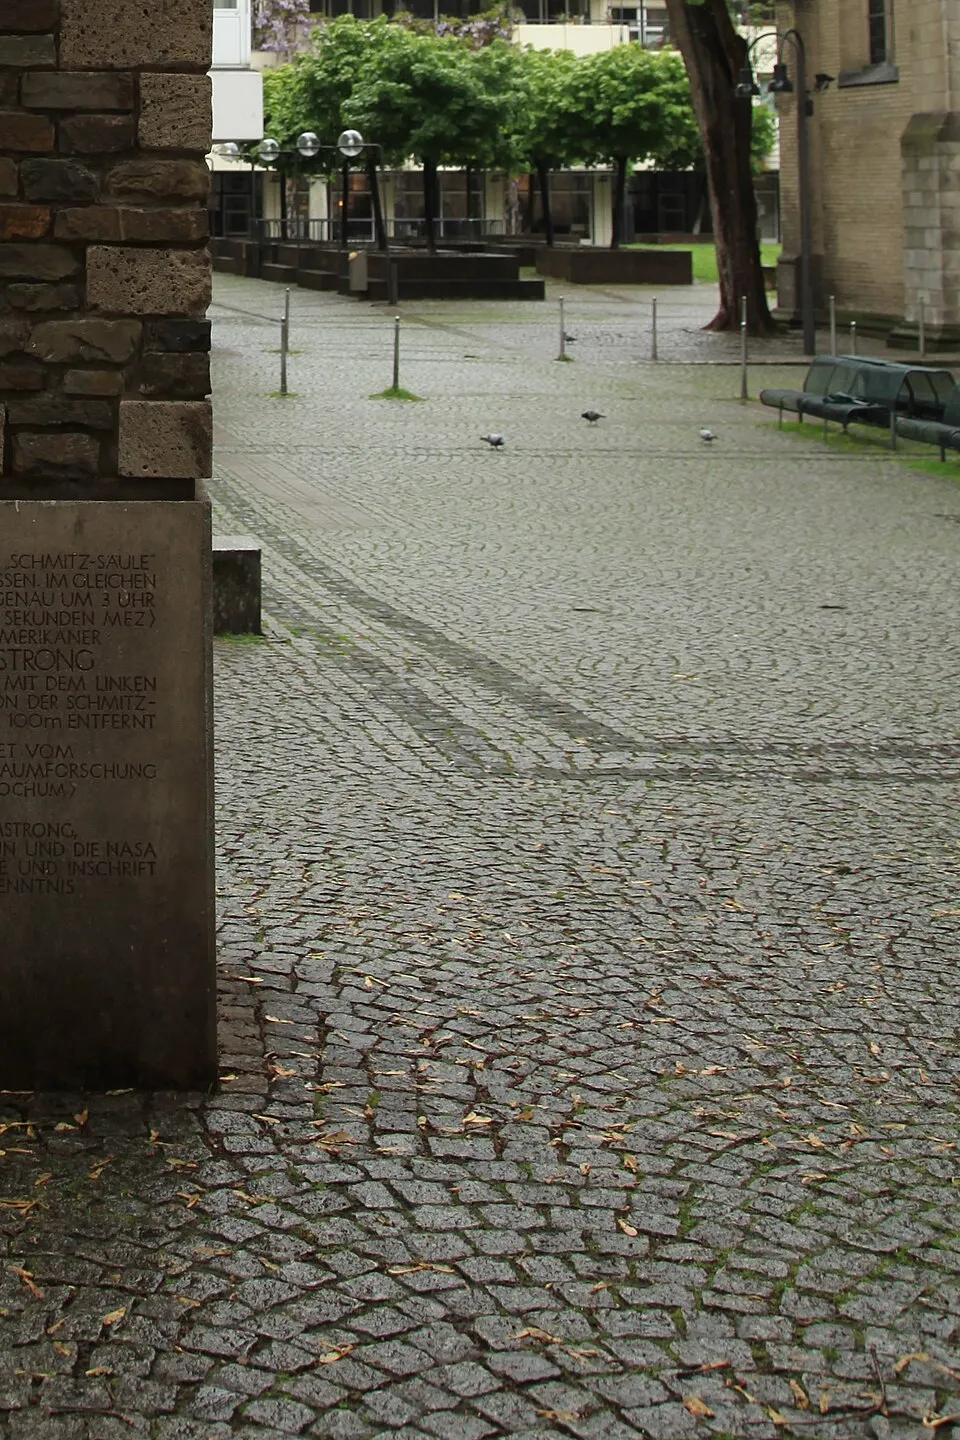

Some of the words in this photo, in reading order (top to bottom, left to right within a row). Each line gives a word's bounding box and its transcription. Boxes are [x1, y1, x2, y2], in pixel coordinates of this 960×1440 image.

[46, 573, 68, 588] IM
[72, 574, 156, 589] GLEICHEN
[61, 592, 92, 607] UM
[101, 593, 110, 607] 3
[118, 593, 155, 608] UHR
[5, 611, 94, 626] SEKUNDEN
[4, 676, 39, 691] MIT
[46, 676, 86, 691] DEM
[95, 676, 156, 691] LINKEN
[28, 695, 58, 710] DER
[66, 695, 156, 710] SCHMITZ-
[68, 714, 156, 729] ENTFERNT
[25, 744, 74, 759] VOM
[25, 841, 65, 857] UND
[74, 842, 99, 857] DIE
[106, 841, 157, 858] NASA
[18, 861, 58, 875] UND
[68, 861, 156, 876] INSCHRIFT
